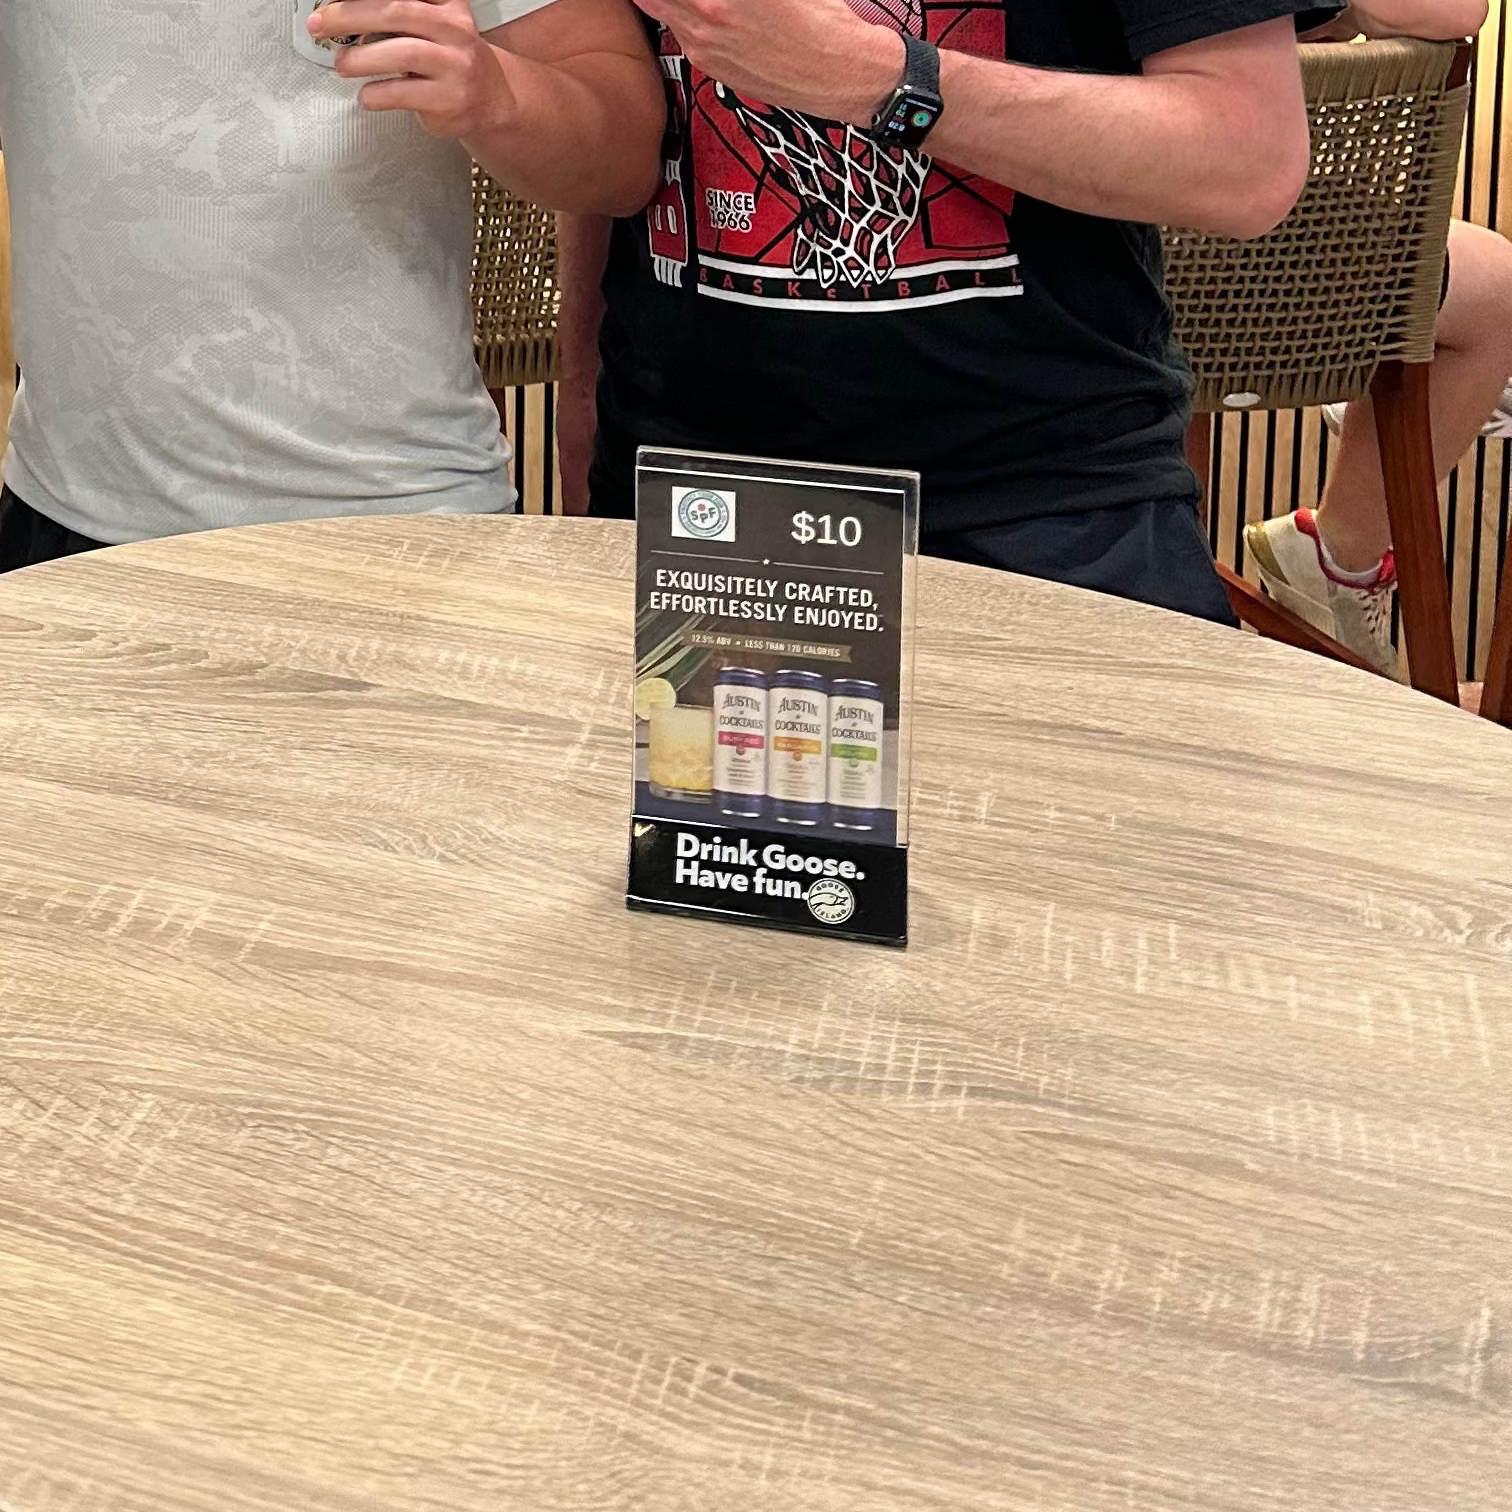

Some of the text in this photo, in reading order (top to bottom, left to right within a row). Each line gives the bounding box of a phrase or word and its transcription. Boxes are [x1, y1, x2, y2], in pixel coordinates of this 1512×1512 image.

[705, 188, 756, 214] SINCE
[709, 210, 752, 232] 1966
[690, 506, 718, 524] SPF
[790, 510, 863, 548] $10
[656, 568, 879, 612] EXQUISITELY CRAFTED,
[649, 590, 884, 633] EFFORTLESSLY ENJOYED.
[744, 638, 764, 650] LESS
[721, 692, 762, 713] AUSTIN
[777, 696, 819, 717] AUSTIN
[719, 714, 764, 730] COCKTAILS
[834, 704, 875, 725] AUSTIN
[775, 719, 821, 735] COCKTAILS
[831, 727, 877, 742] COCKTAILS
[676, 832, 866, 881] Drink Goose.
[674, 858, 809, 901] Have fun.
